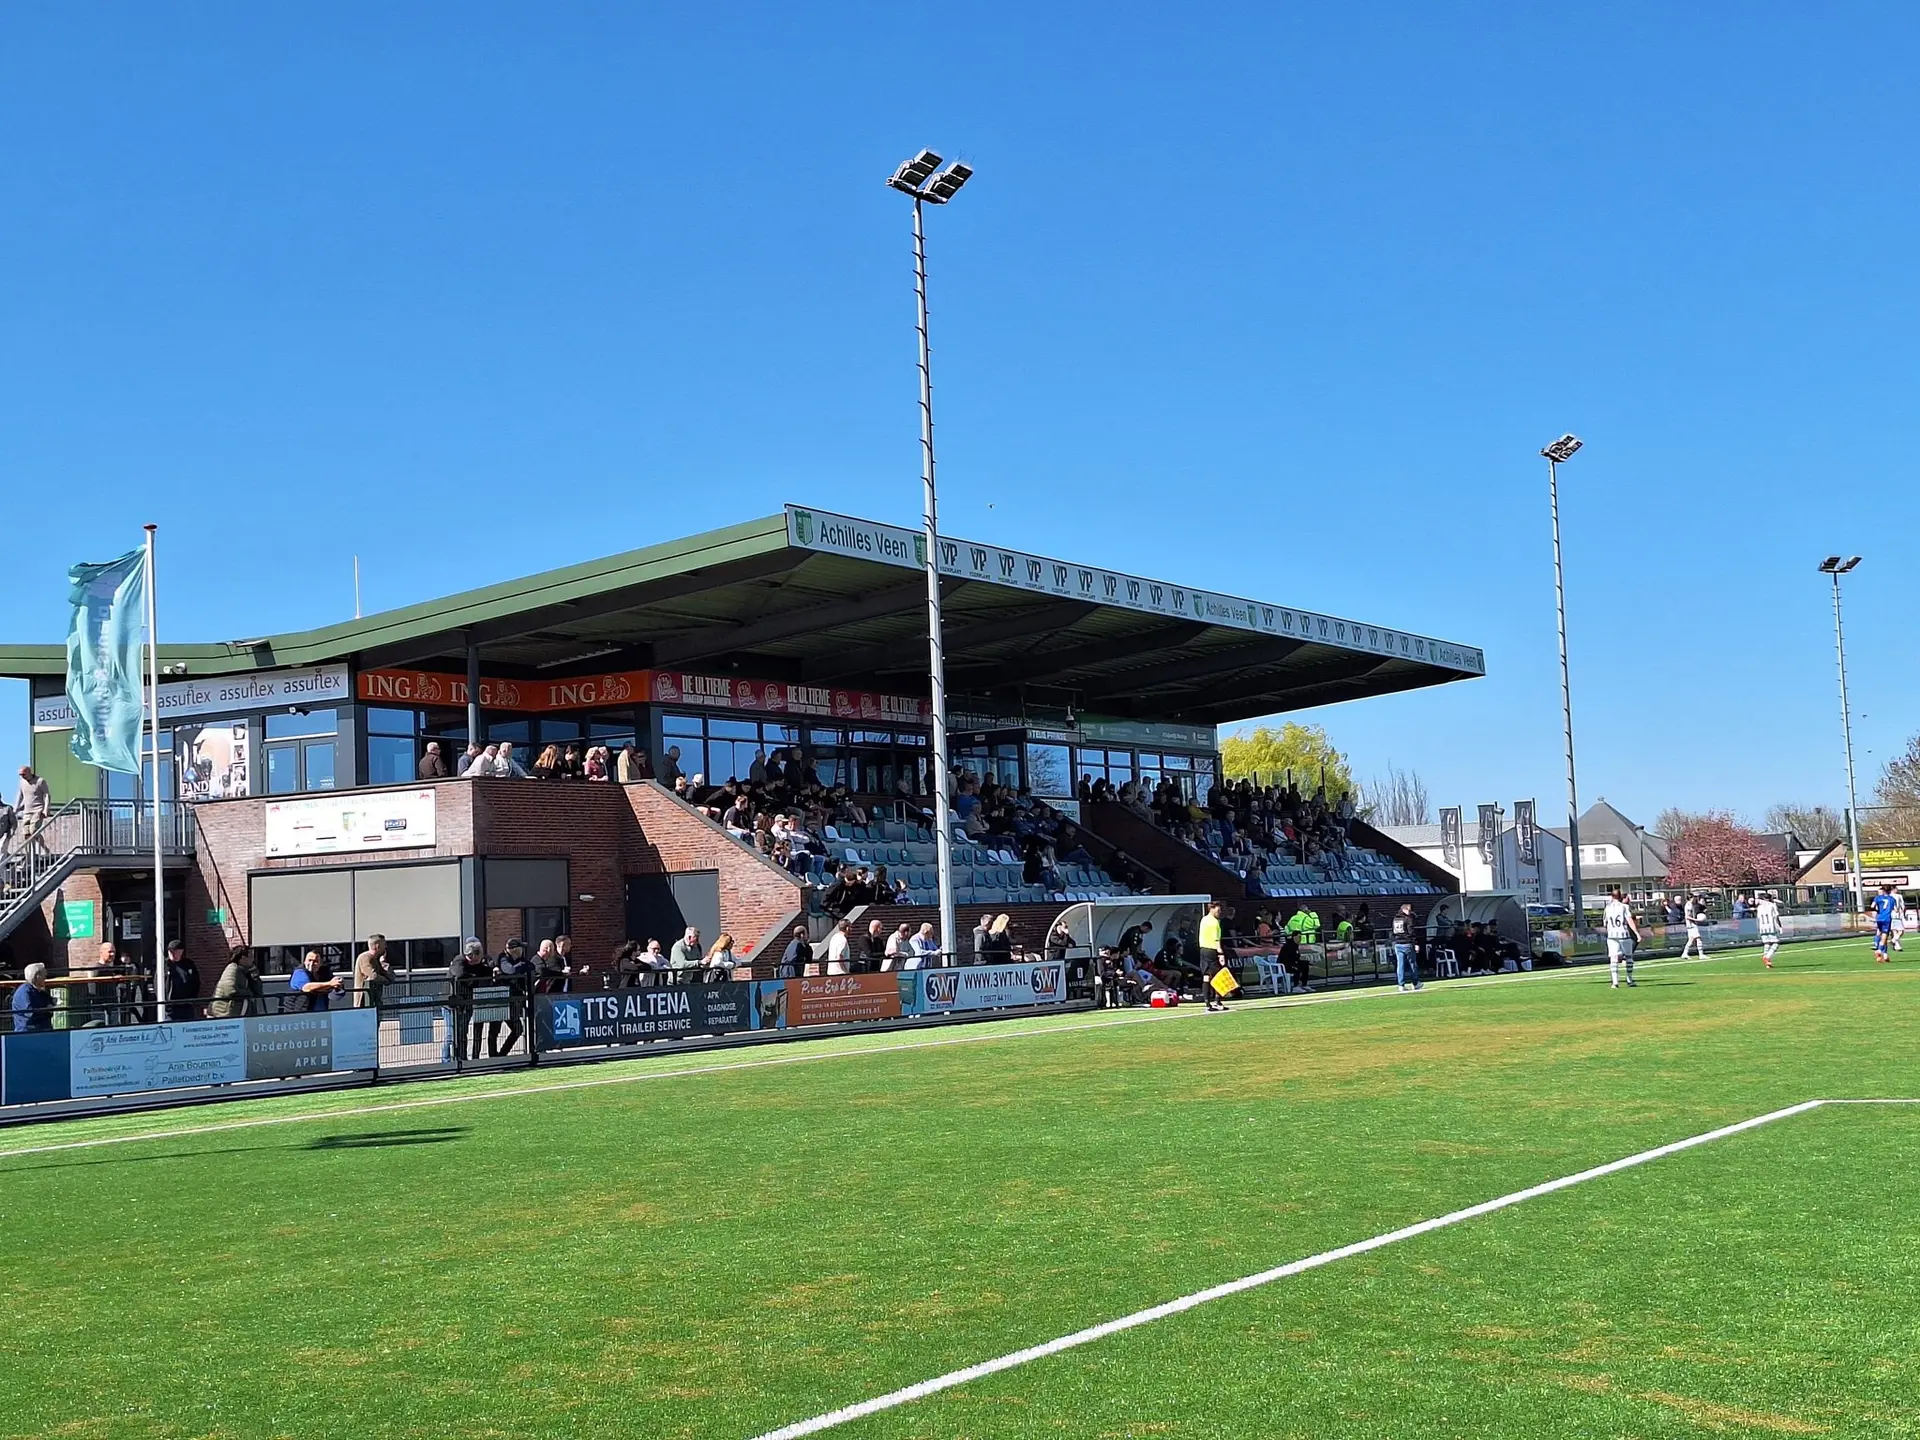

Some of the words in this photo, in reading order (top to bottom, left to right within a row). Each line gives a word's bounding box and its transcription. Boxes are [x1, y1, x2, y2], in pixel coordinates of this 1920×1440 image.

[820, 520, 872, 552] Achilles
[875, 531, 908, 559] Veen
[1206, 601, 1230, 618] Achilles
[1231, 606, 1248, 622] Veen
[219, 681, 275, 701] assuflex
[283, 674, 340, 694] assuflex
[366, 674, 411, 699] ING
[682, 674, 694, 694] DE
[695, 676, 731, 697] ULTIEME
[158, 689, 211, 708] assuflex
[550, 683, 597, 706] ING
[787, 685, 797, 703] DE
[798, 686, 831, 706] ULTIEME
[39, 699, 77, 721] assufl
[1882, 899, 1889, 909] 7
[1610, 915, 1621, 928] 16
[1760, 914, 1770, 925] 11
[928, 975, 957, 1000] 3WT
[963, 970, 1029, 990] WWW.3WT.NL
[1033, 969, 1058, 992] 3WT
[583, 997, 619, 1021] TTS
[624, 991, 691, 1018] ALTENA
[707, 1002, 737, 1012] DIAGNOSE
[258, 1019, 316, 1034] Reparatie
[584, 1025, 614, 1038] TRUCK
[620, 1021, 656, 1035] TRAILER
[657, 1018, 692, 1032] SERVICE
[708, 1015, 738, 1025] REPARATIE
[252, 1038, 317, 1052] Onderhoud
[187, 1060, 222, 1070] Bouman
[295, 1056, 317, 1068] APK
